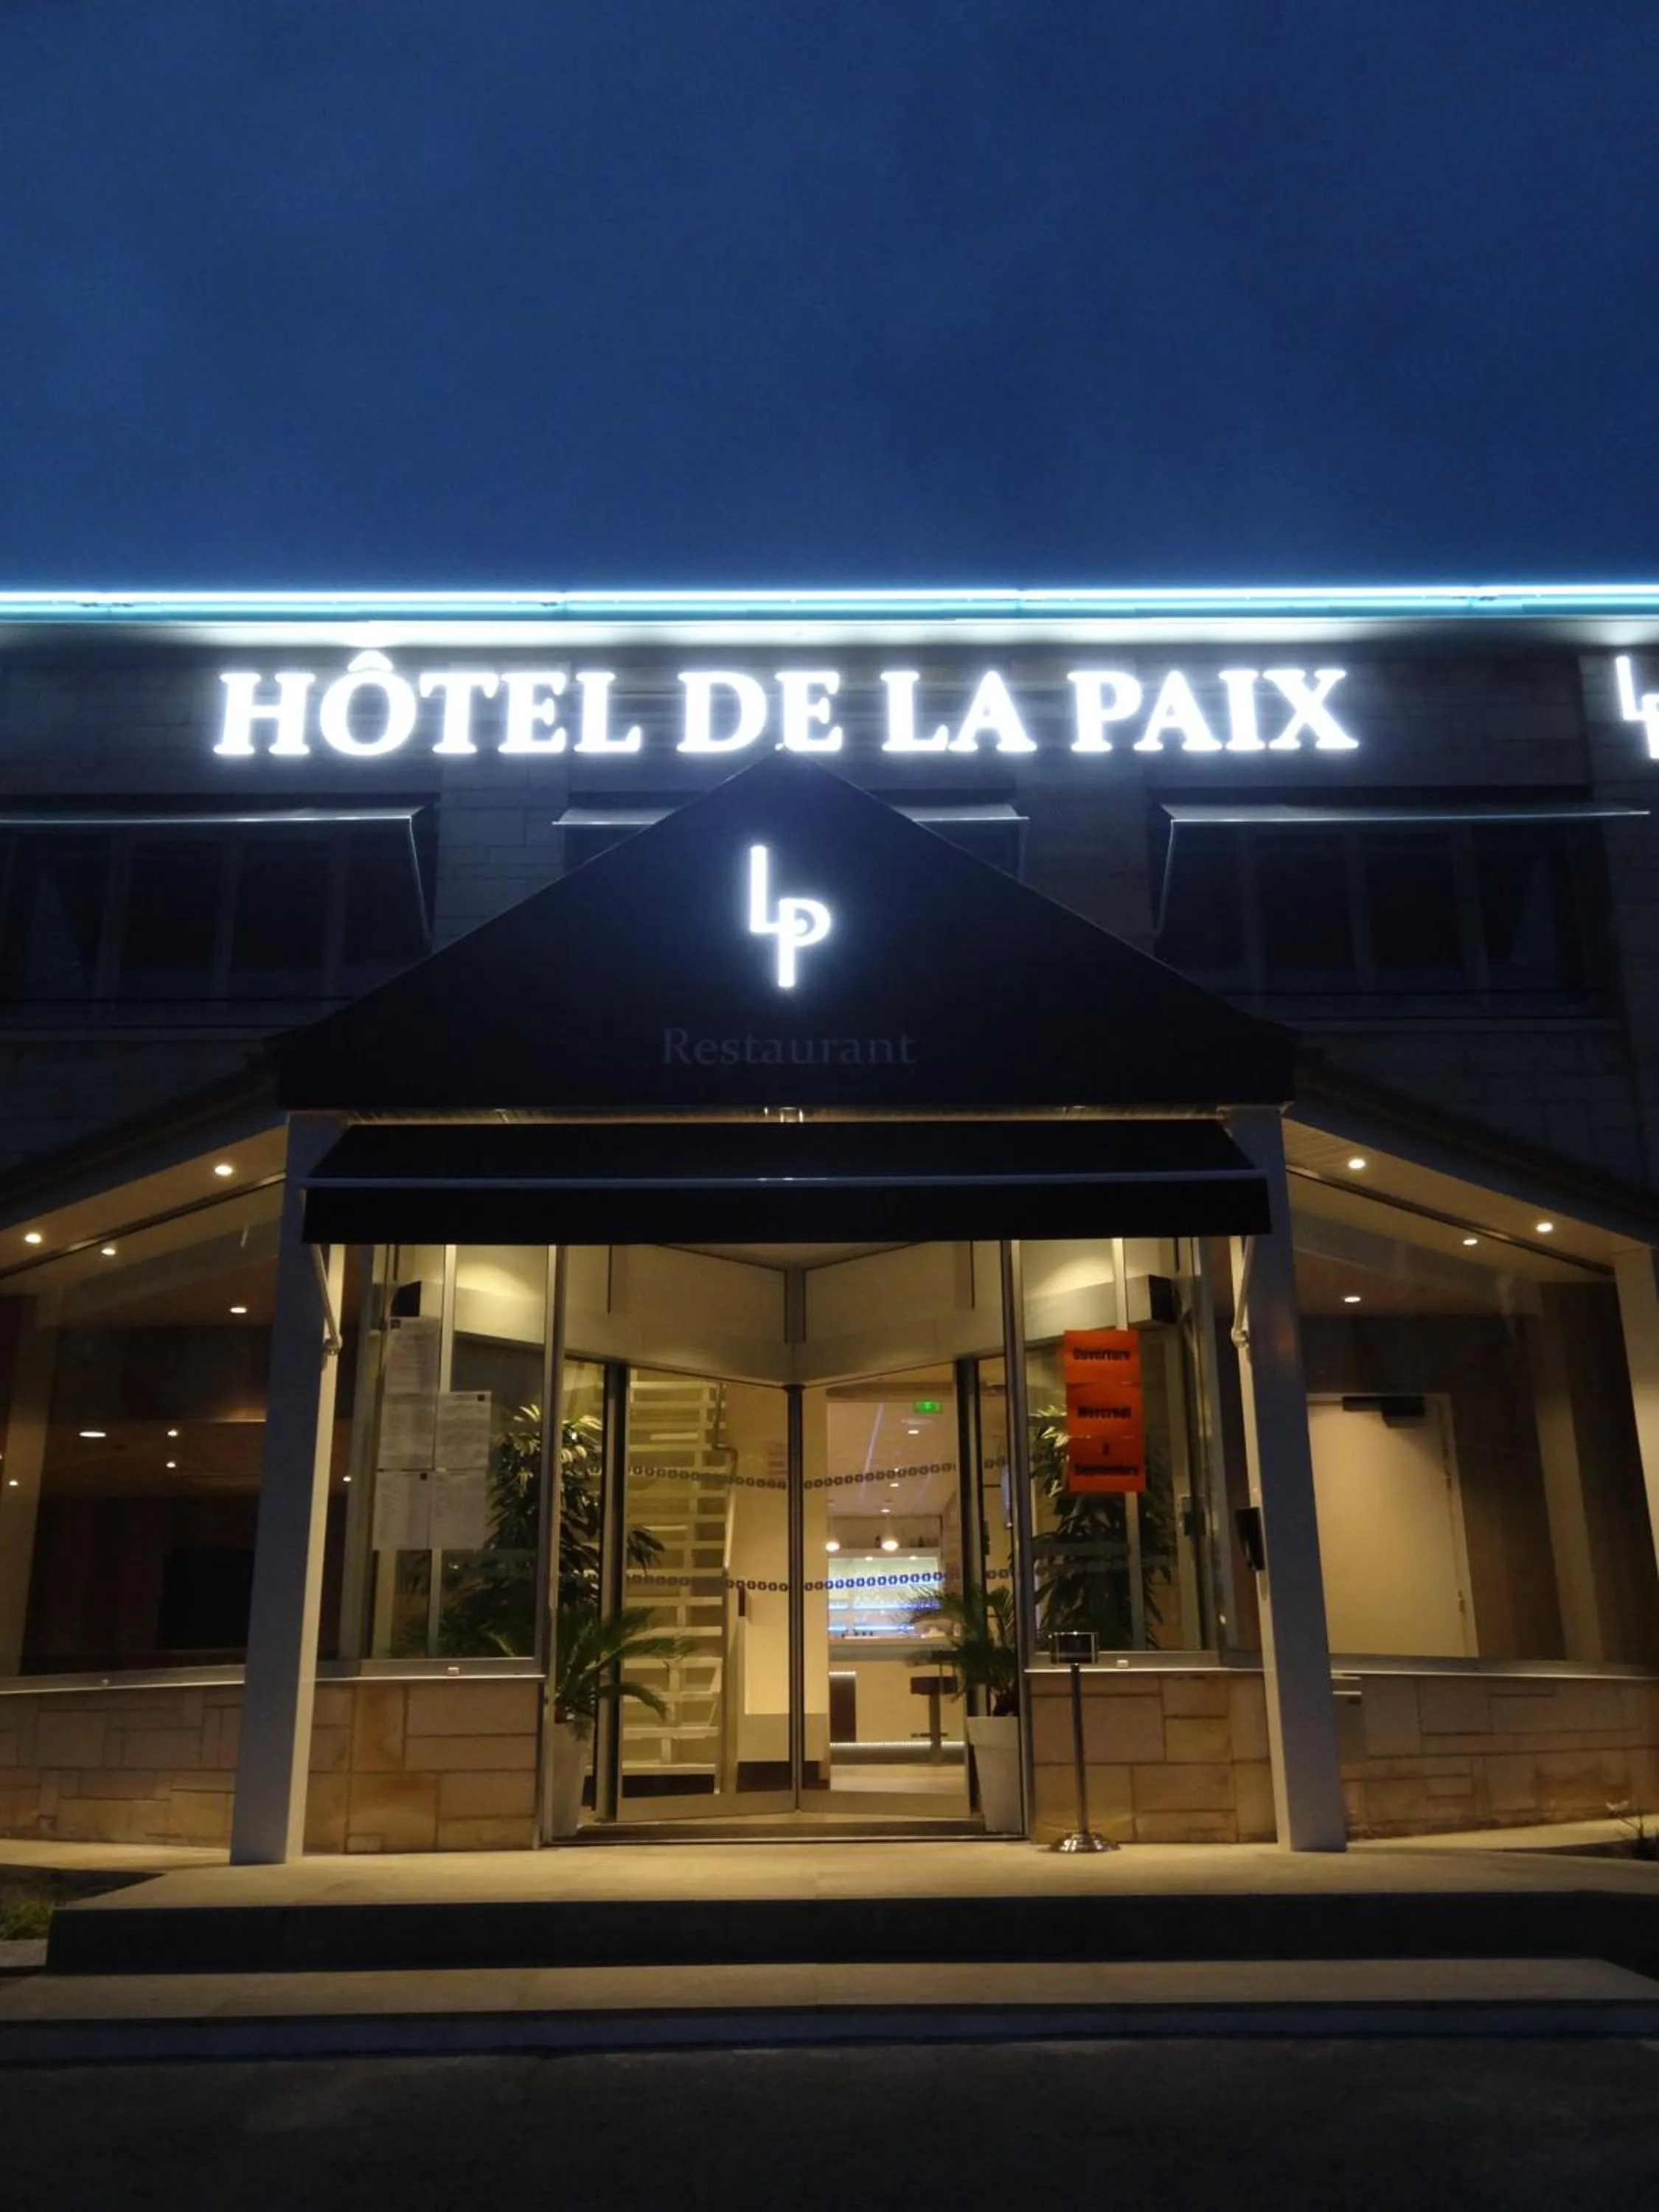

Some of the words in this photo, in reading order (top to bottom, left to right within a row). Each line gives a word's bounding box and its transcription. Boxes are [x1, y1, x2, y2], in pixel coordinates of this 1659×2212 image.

[213, 649, 642, 756] HÔTEL
[676, 670, 844, 754] DE
[880, 669, 1037, 753] LA
[1066, 667, 1360, 752] PAIX
[661, 1027, 917, 1065] Restaurant
